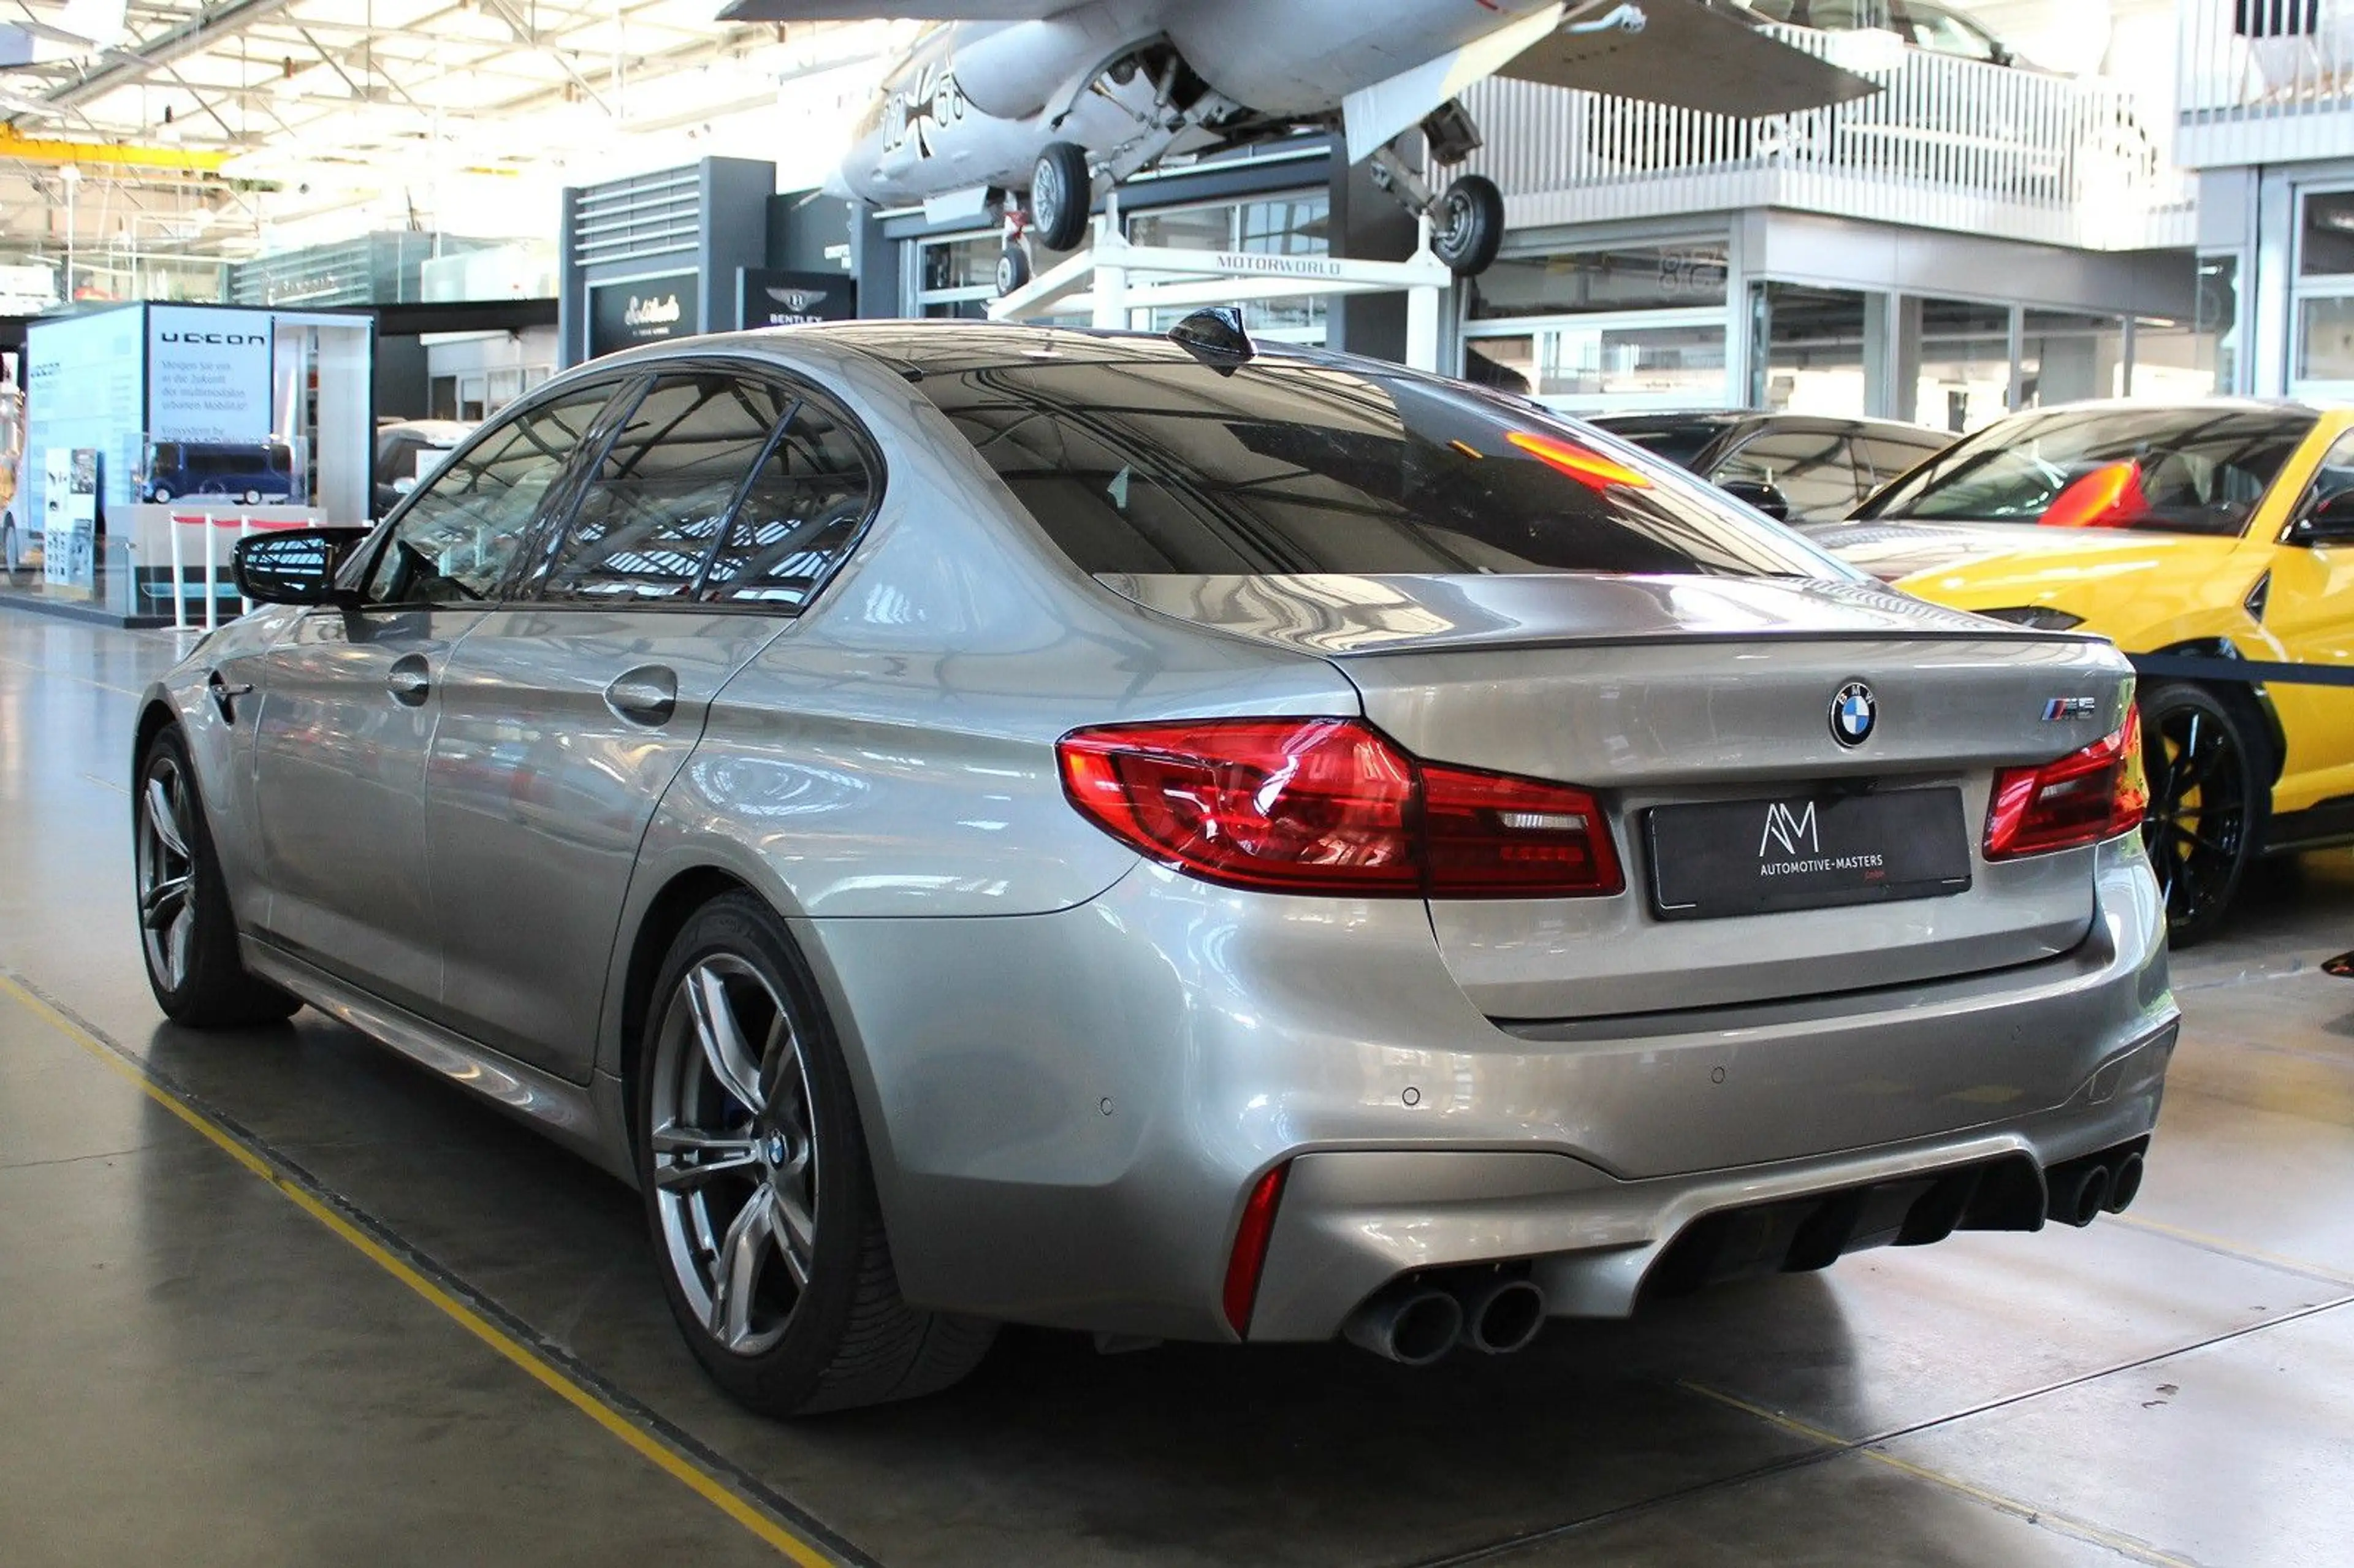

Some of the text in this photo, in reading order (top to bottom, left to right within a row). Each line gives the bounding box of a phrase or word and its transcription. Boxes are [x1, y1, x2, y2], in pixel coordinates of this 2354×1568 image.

[1217, 255, 1341, 275] MOTORWORLD
[769, 313, 823, 324] BENTLEY
[1837, 685, 1874, 705] BMW
[1761, 854, 1883, 876] AUTOMOTIVE-MASTERS
